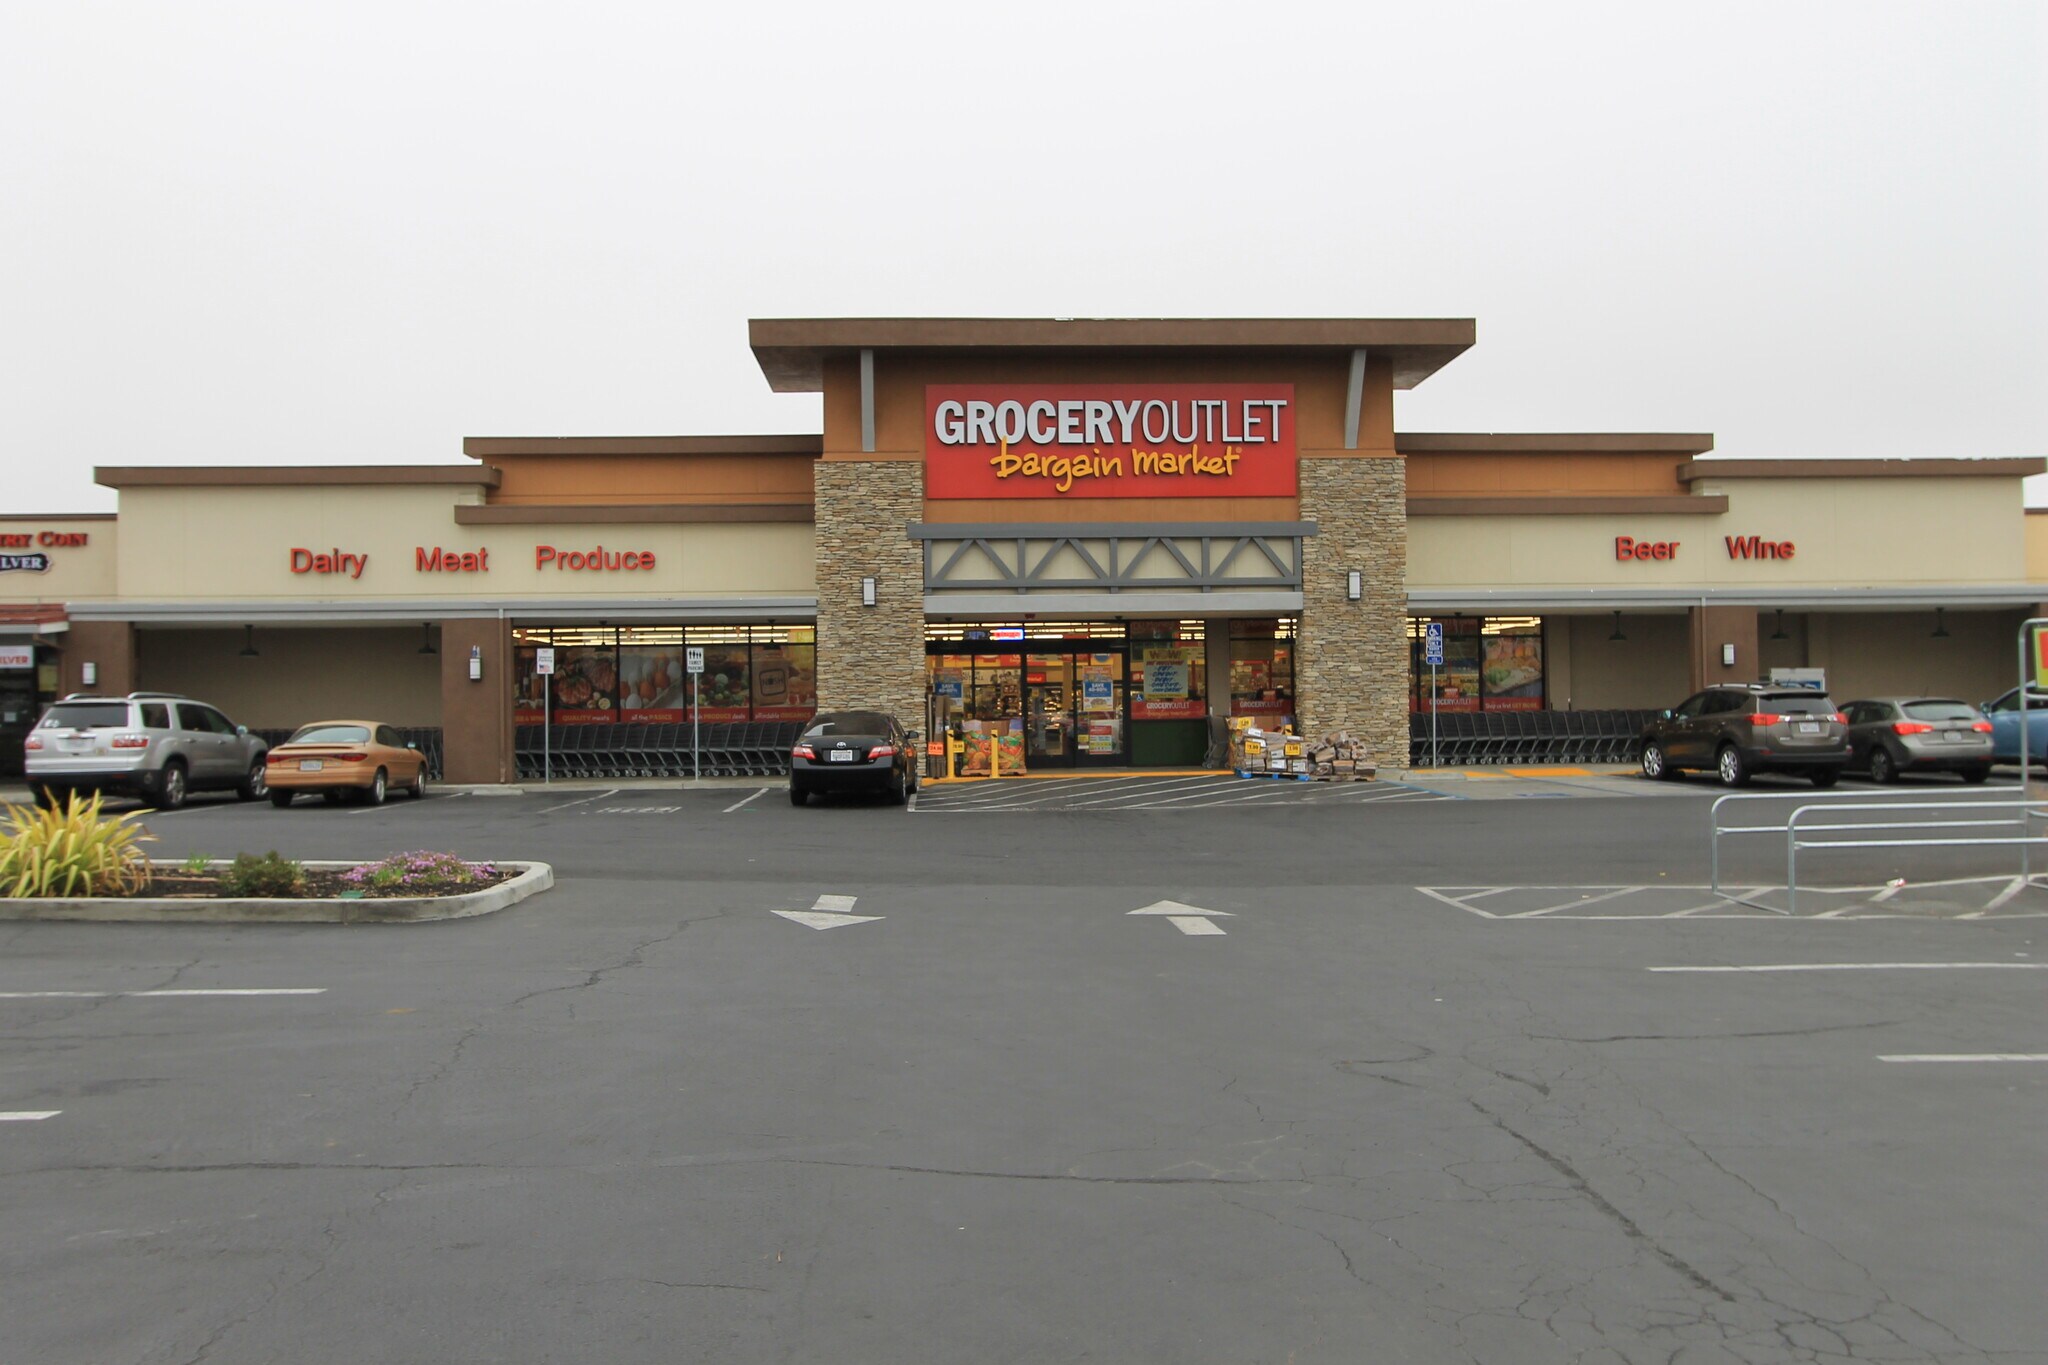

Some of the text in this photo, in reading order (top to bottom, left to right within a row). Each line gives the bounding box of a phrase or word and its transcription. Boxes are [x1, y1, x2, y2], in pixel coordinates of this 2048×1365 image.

[990, 435, 1241, 492] bargain market
[415, 547, 489, 572] Meat
[535, 545, 656, 571] Produce
[1614, 536, 1680, 561] Beer
[1725, 535, 1795, 560] Wine
[290, 547, 368, 579] Dairy
